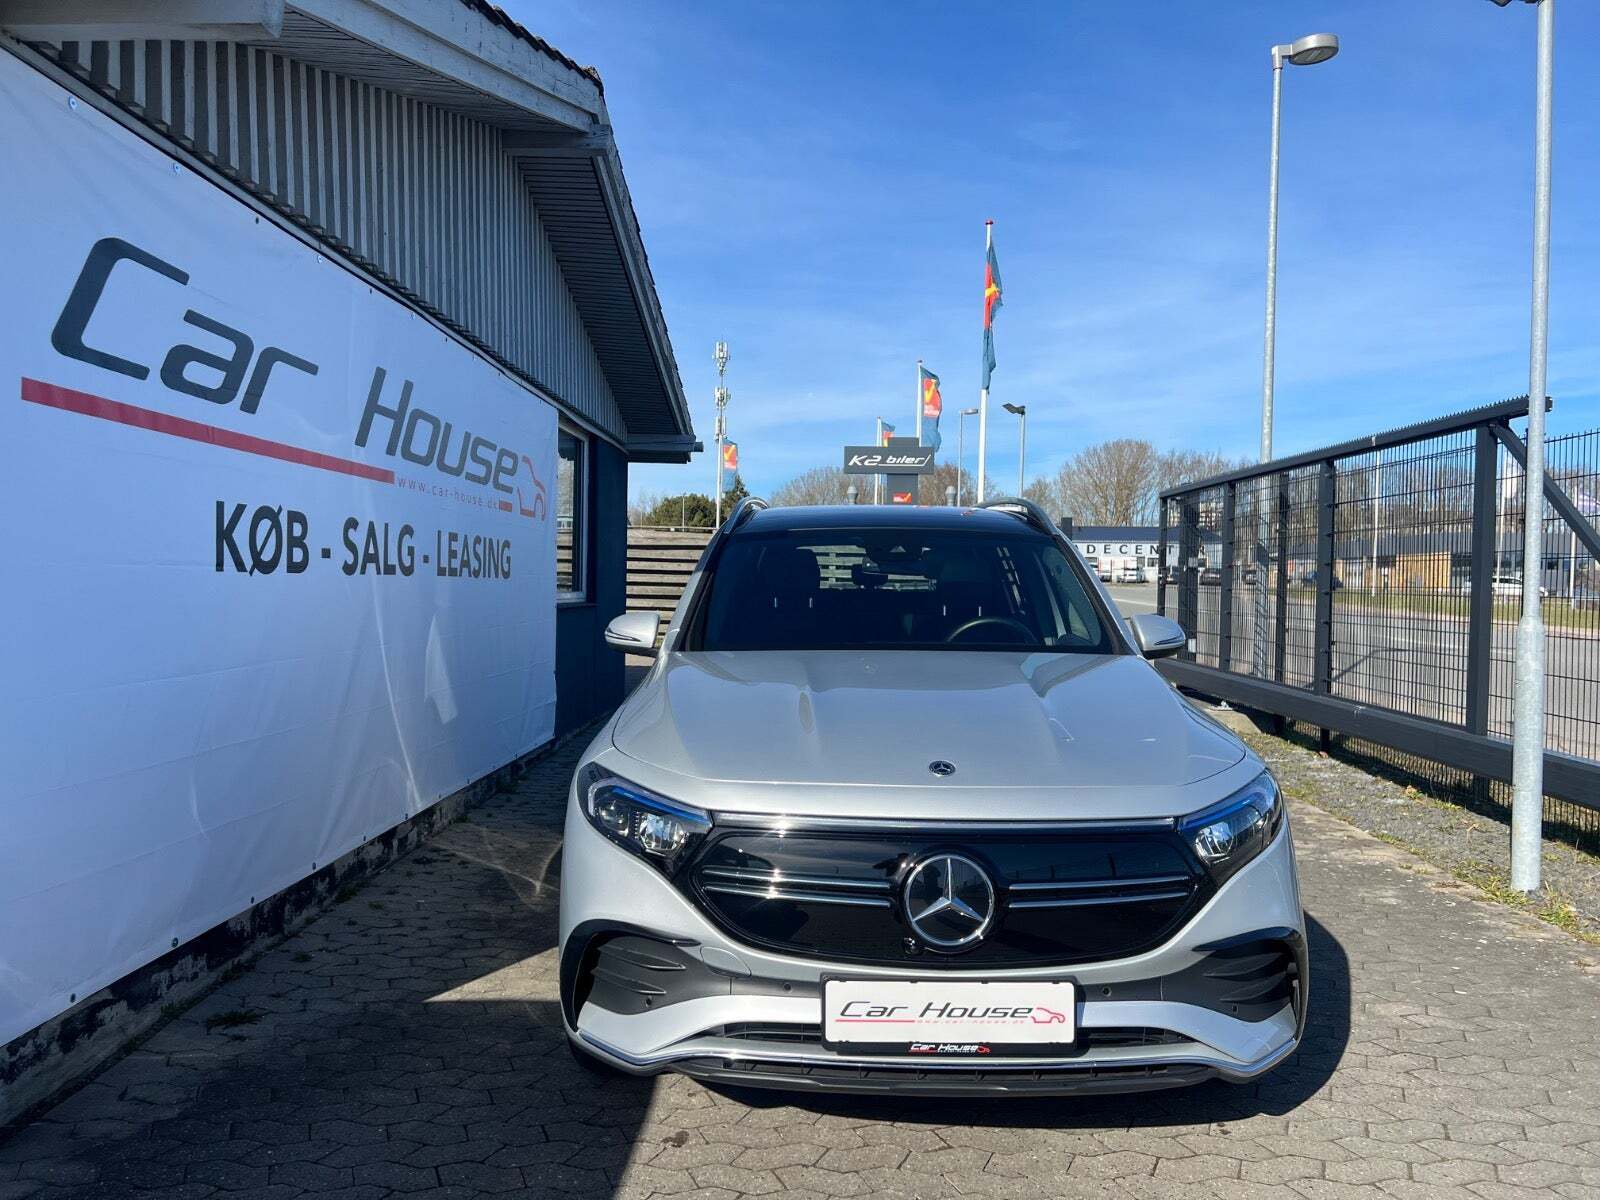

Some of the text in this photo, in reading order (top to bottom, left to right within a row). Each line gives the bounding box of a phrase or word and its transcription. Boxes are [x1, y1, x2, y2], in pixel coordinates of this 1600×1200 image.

[50, 237, 519, 495] Car House
[848, 455, 882, 466] K2
[215, 500, 310, 577] KØB
[342, 517, 416, 577] SALG
[436, 530, 512, 580] LEASING
[840, 1001, 1034, 1019] Car House
[910, 1043, 936, 1051] Car
[936, 1043, 979, 1053] House
